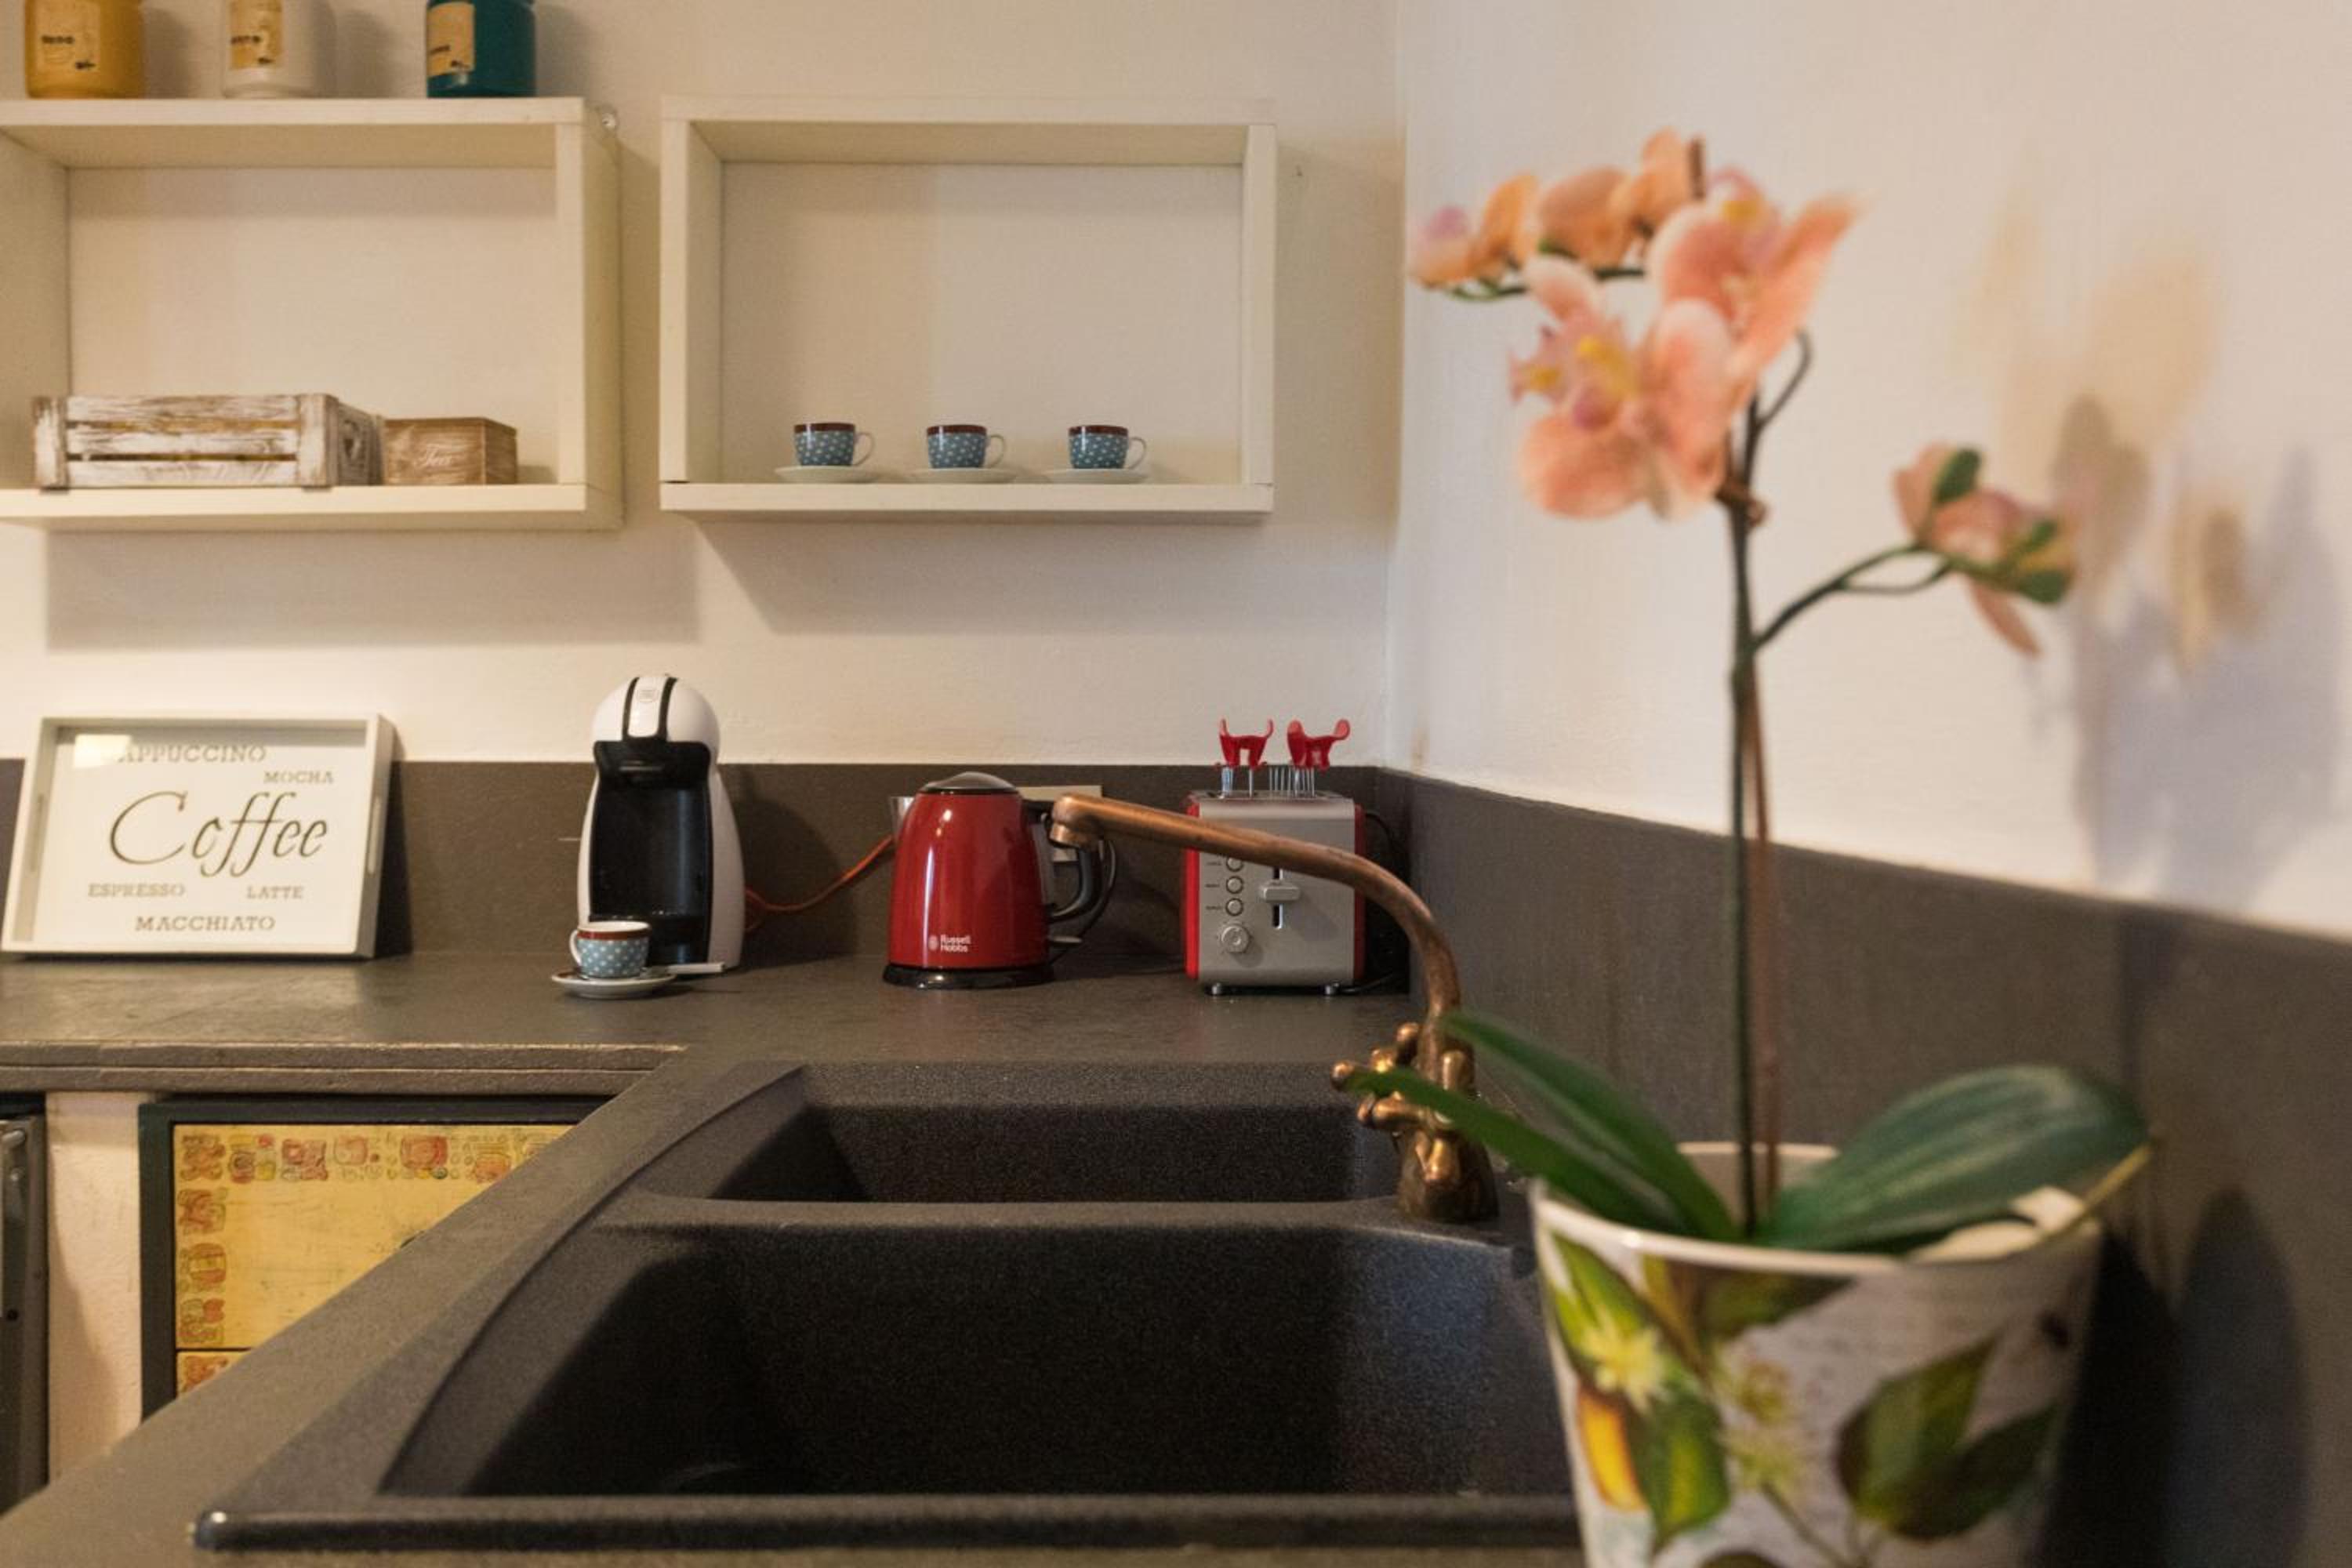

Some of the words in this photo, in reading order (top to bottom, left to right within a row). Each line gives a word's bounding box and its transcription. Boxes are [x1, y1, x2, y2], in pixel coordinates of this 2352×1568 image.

[114, 745, 267, 764] APPUCCINO
[263, 771, 335, 784] MOCHA
[110, 790, 328, 877] Coffee
[88, 883, 187, 898] ESPRESSO
[246, 886, 305, 900] LATTE
[135, 916, 276, 933] MACCHIATO
[940, 934, 971, 944] Russell
